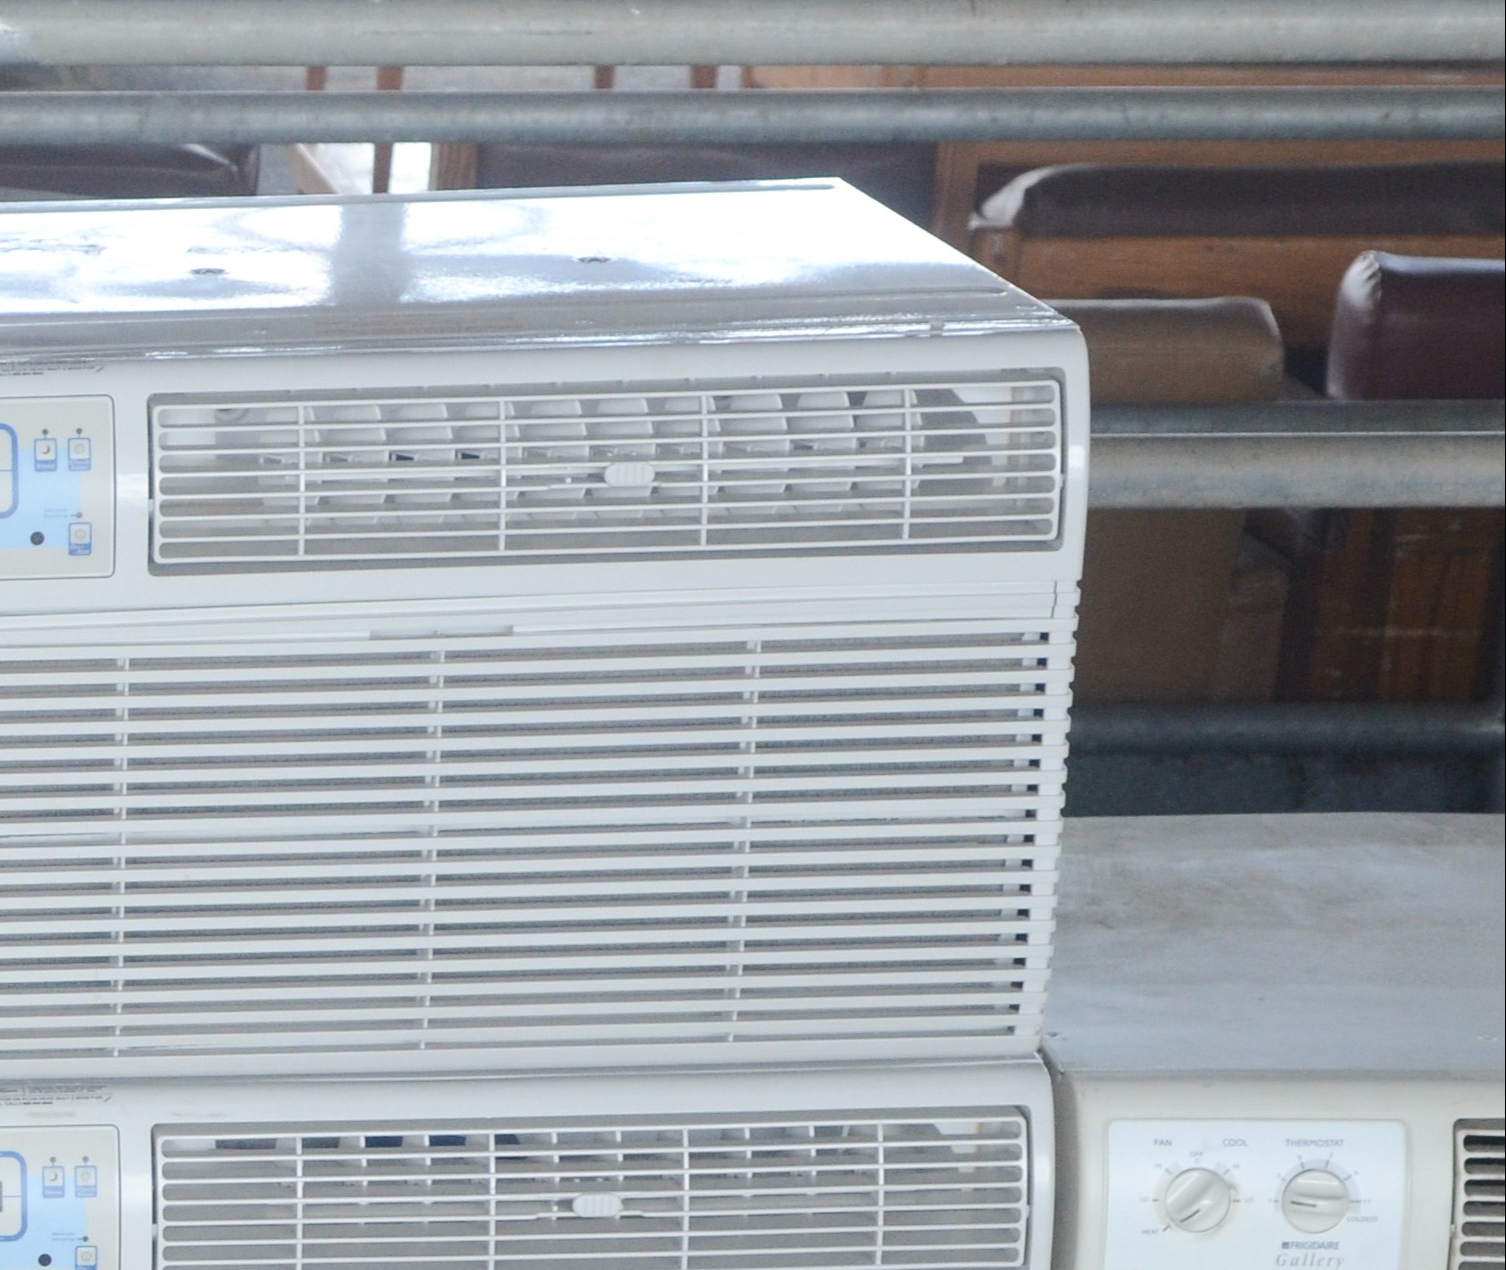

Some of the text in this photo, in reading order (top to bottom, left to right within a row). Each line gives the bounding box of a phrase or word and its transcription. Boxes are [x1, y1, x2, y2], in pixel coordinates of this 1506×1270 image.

[1153, 1138, 1173, 1147] FAN
[1222, 1138, 1249, 1147] COOL
[1285, 1139, 1344, 1148] THERMOSTAT
[1289, 1241, 1340, 1250] FRIGIDAIRE
[1275, 1252, 1345, 1270] Gallery
